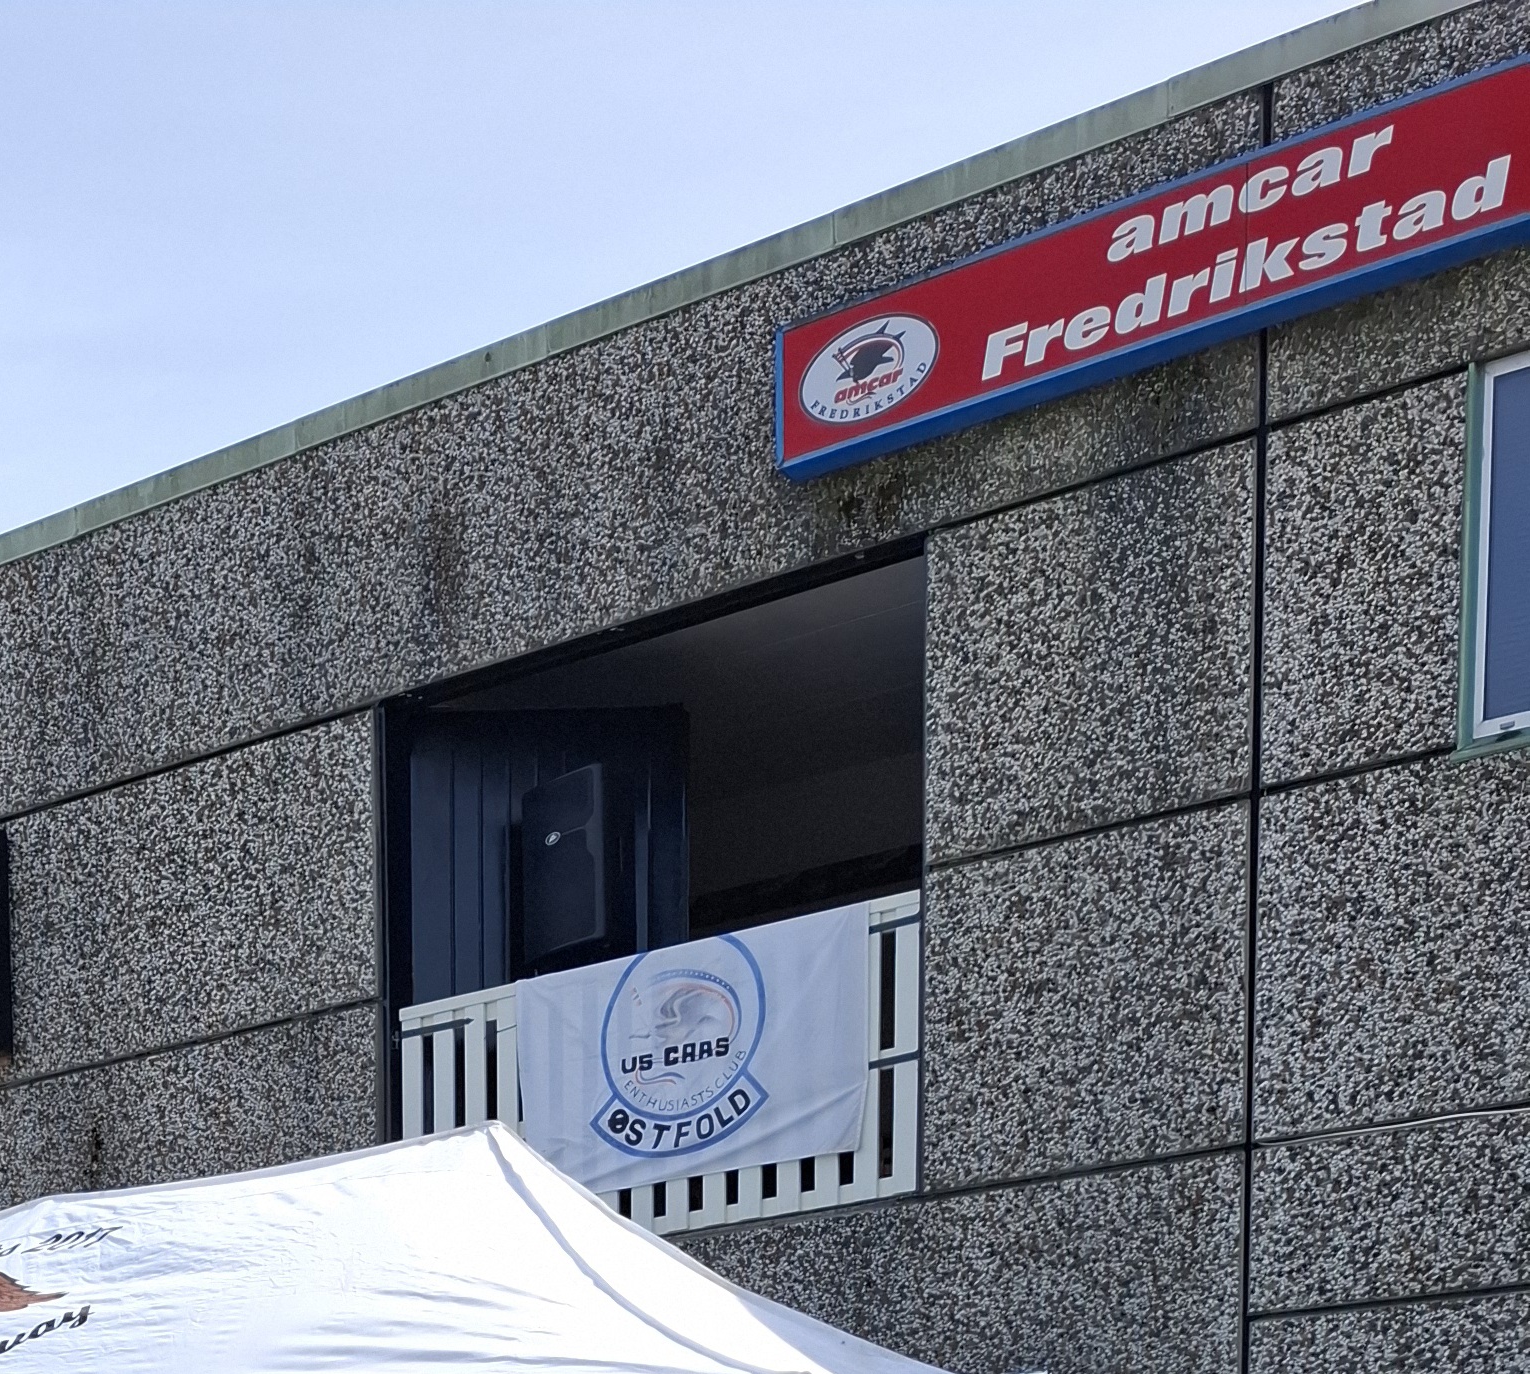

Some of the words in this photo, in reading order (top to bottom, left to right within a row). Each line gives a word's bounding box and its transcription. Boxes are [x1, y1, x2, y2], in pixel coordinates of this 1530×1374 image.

[1106, 123, 1395, 264] amcar
[980, 153, 1513, 382] Fredrikstad
[810, 362, 927, 420] FREDRIKSTAD
[834, 367, 903, 404] amcar
[621, 1053, 654, 1074] US
[663, 1036, 730, 1067] CARS
[713, 1047, 748, 1094] CLUB
[608, 1086, 751, 1151] ØSTFOLD
